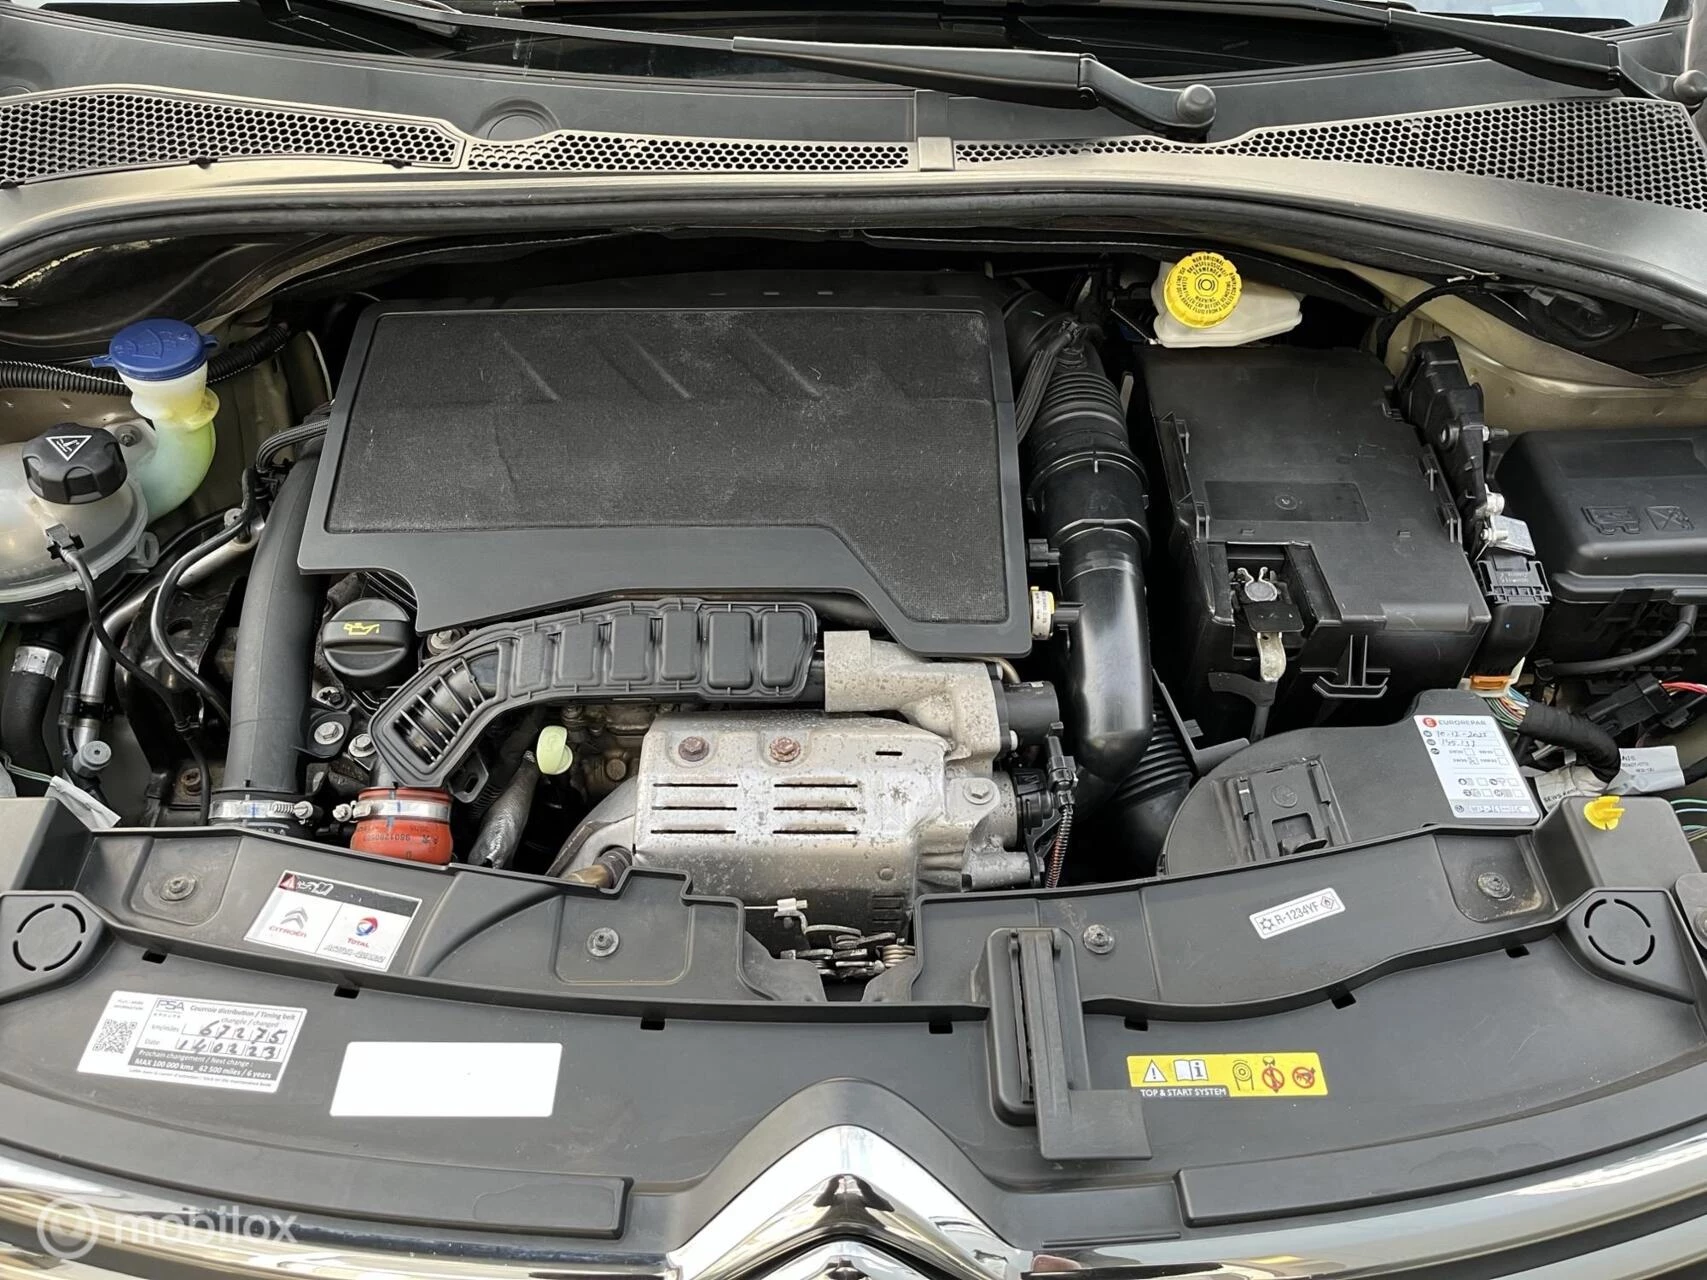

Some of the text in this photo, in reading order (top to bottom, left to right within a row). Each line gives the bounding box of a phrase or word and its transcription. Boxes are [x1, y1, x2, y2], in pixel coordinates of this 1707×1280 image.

[1274, 901, 1319, 925] R-1234YF
[347, 937, 369, 948] TOTAL
[156, 1000, 185, 1012] PSA
[218, 1006, 254, 1017] distribution
[261, 1011, 281, 1020] Timing
[282, 1012, 296, 1020] belt
[138, 1049, 166, 1058] Prochain
[166, 1052, 205, 1062] changement
[135, 1058, 152, 1066] MAX
[152, 1059, 166, 1068] 100
[166, 1060, 179, 1069] 000
[208, 1065, 223, 1074] 500
[223, 1066, 241, 1076] miles
[253, 1071, 272, 1080] years
[1166, 1088, 1193, 1097] START
[1194, 1087, 1227, 1097] SYSTEM
